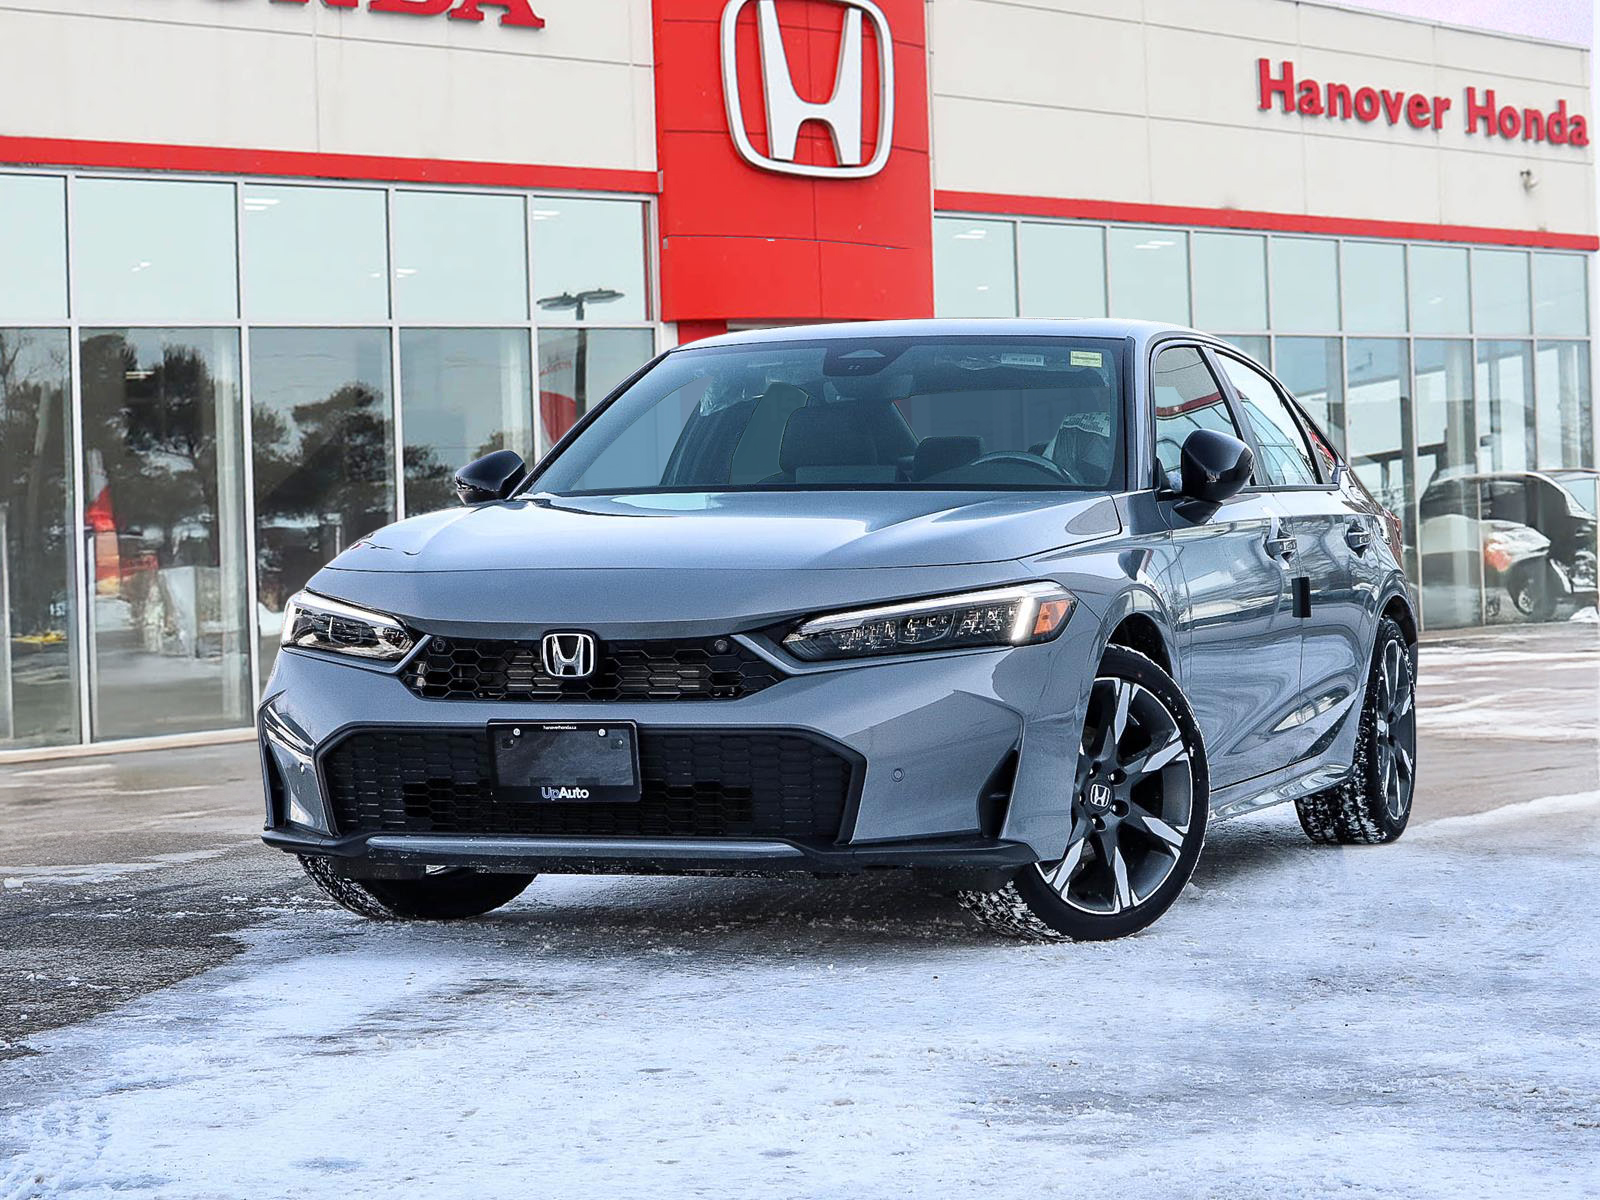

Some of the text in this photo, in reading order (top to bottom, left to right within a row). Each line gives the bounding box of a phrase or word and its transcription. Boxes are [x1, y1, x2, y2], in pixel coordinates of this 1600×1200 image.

[1258, 58, 1590, 147] Hanover Honda
[541, 786, 590, 801] UpAuto
